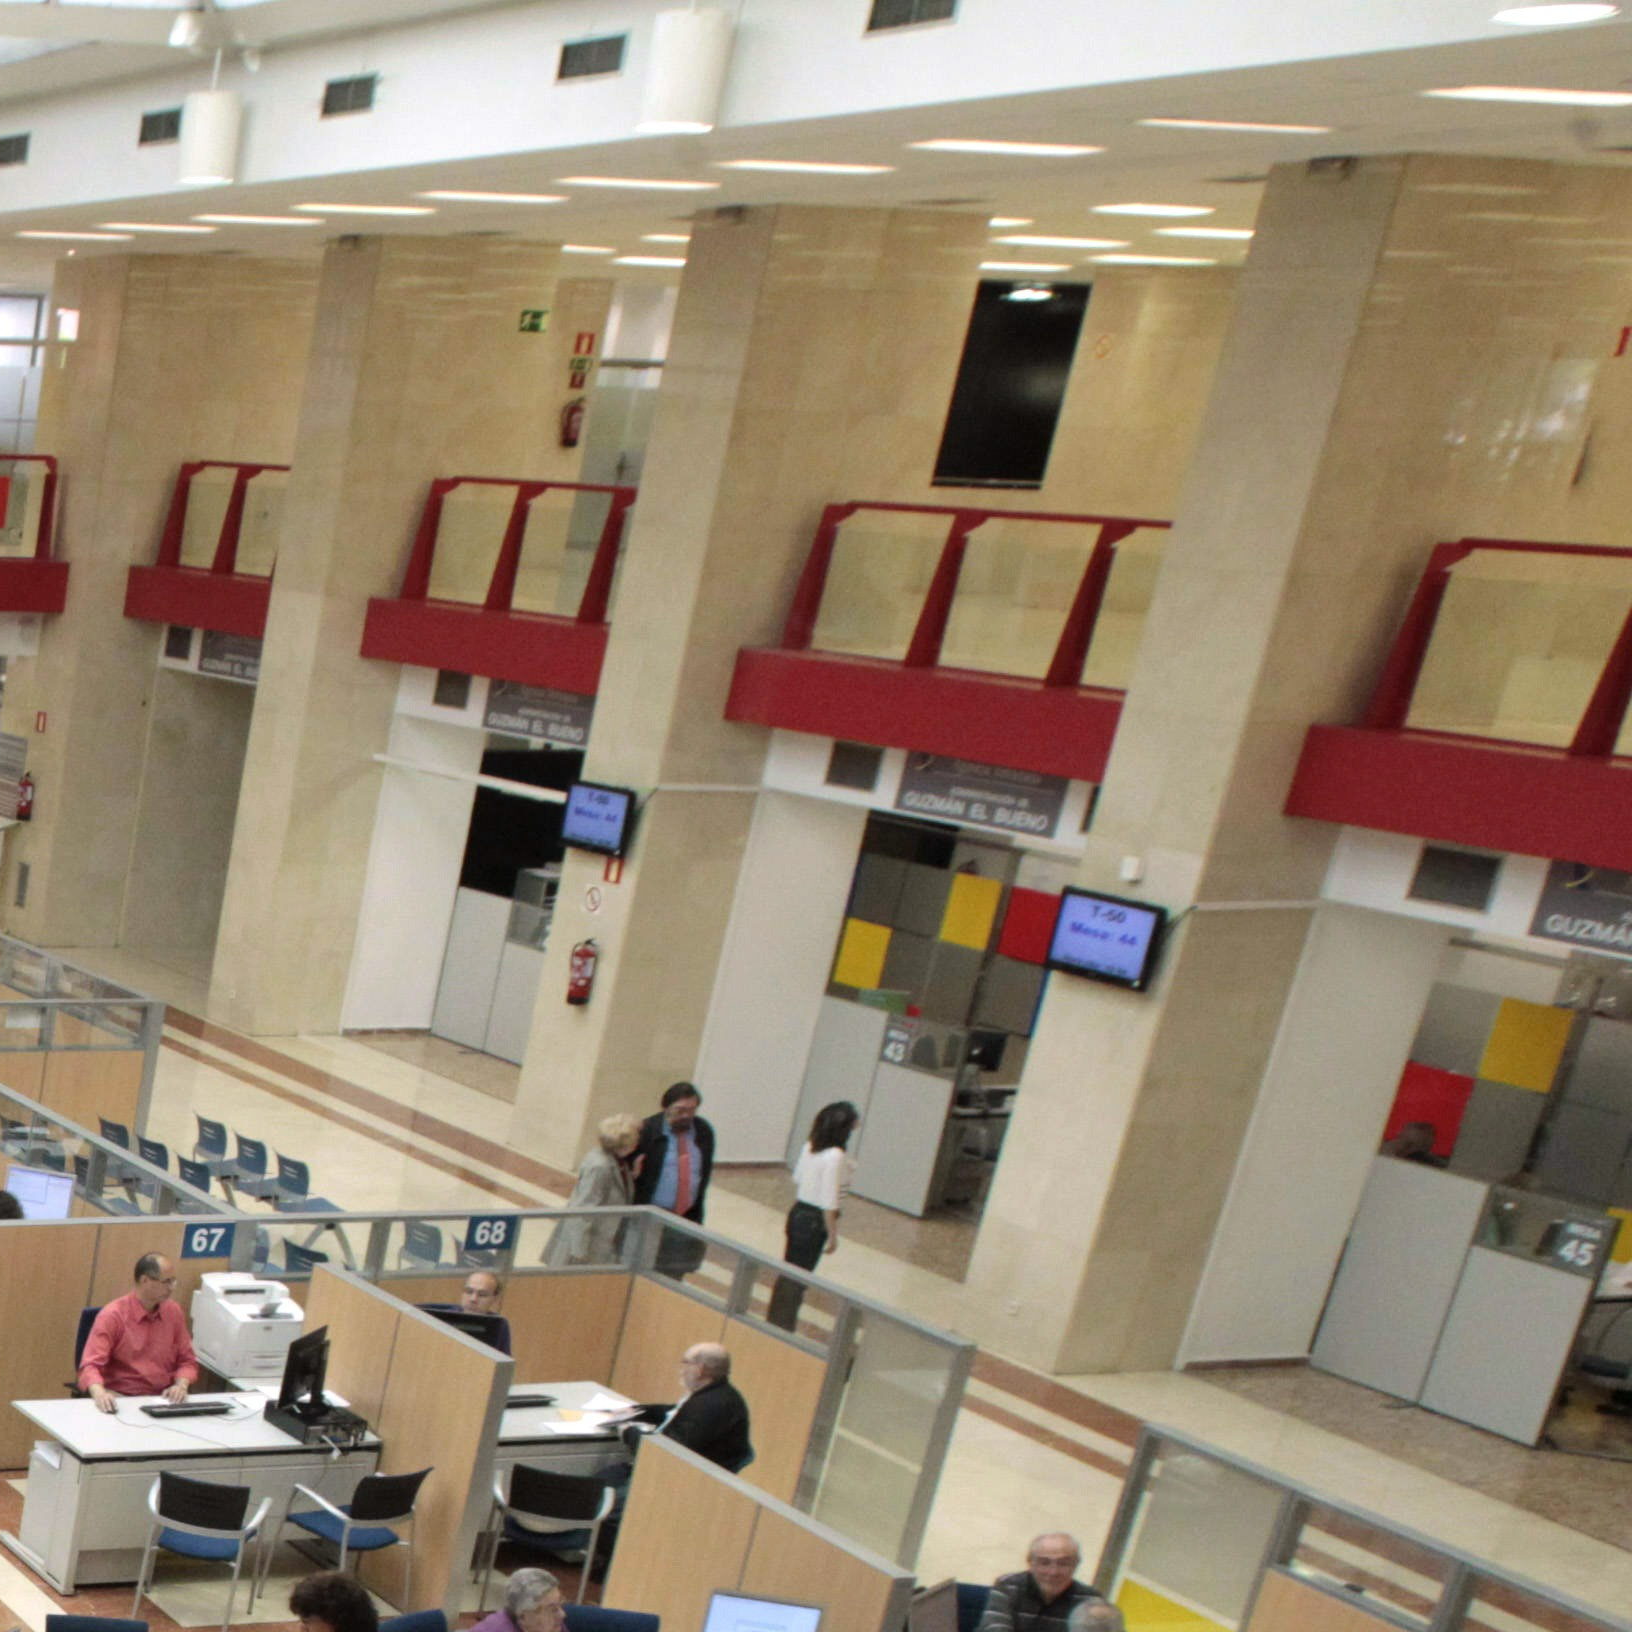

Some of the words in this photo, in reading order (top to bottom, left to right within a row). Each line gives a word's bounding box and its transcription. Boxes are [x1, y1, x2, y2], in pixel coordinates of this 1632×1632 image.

[885, 1041, 905, 1062] 43
[190, 1226, 227, 1254] 67
[473, 1219, 508, 1246] 68
[1558, 1240, 1597, 1267] 45
